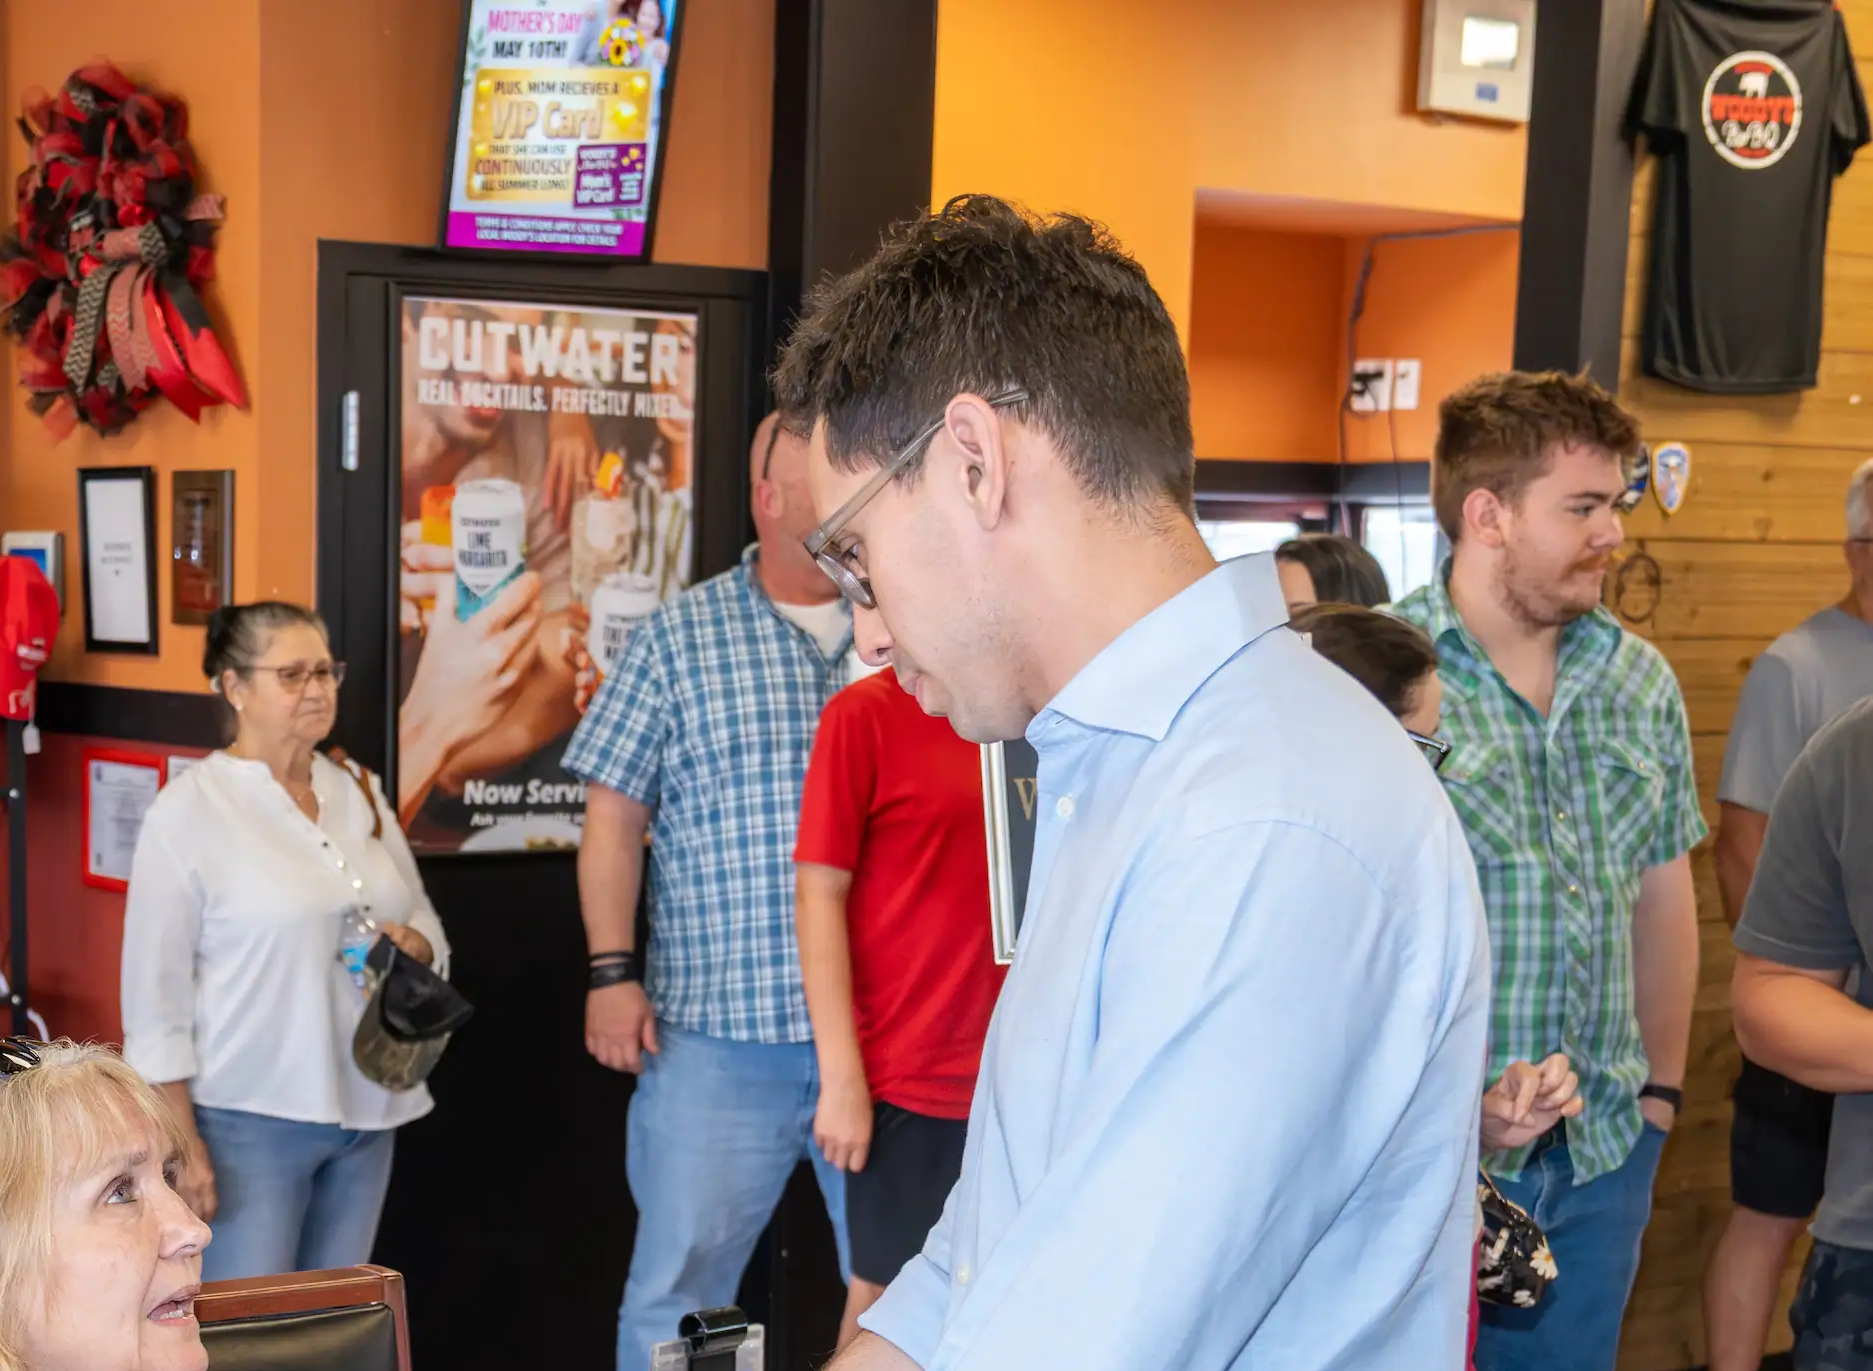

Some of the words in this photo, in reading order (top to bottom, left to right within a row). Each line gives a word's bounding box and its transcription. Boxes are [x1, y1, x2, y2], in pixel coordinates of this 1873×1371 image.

[557, 12, 582, 34] DAY
[492, 40, 523, 58] MAY
[529, 82, 555, 94] MOM
[492, 100, 538, 139] VIP
[544, 99, 604, 139] Card
[475, 159, 572, 176] CONTINUOUSLY
[419, 316, 679, 386] CUTWATER
[418, 379, 455, 407] REAL
[552, 387, 630, 416] PERFECTLY
[463, 779, 523, 805] Now
[526, 778, 587, 804] Servi
